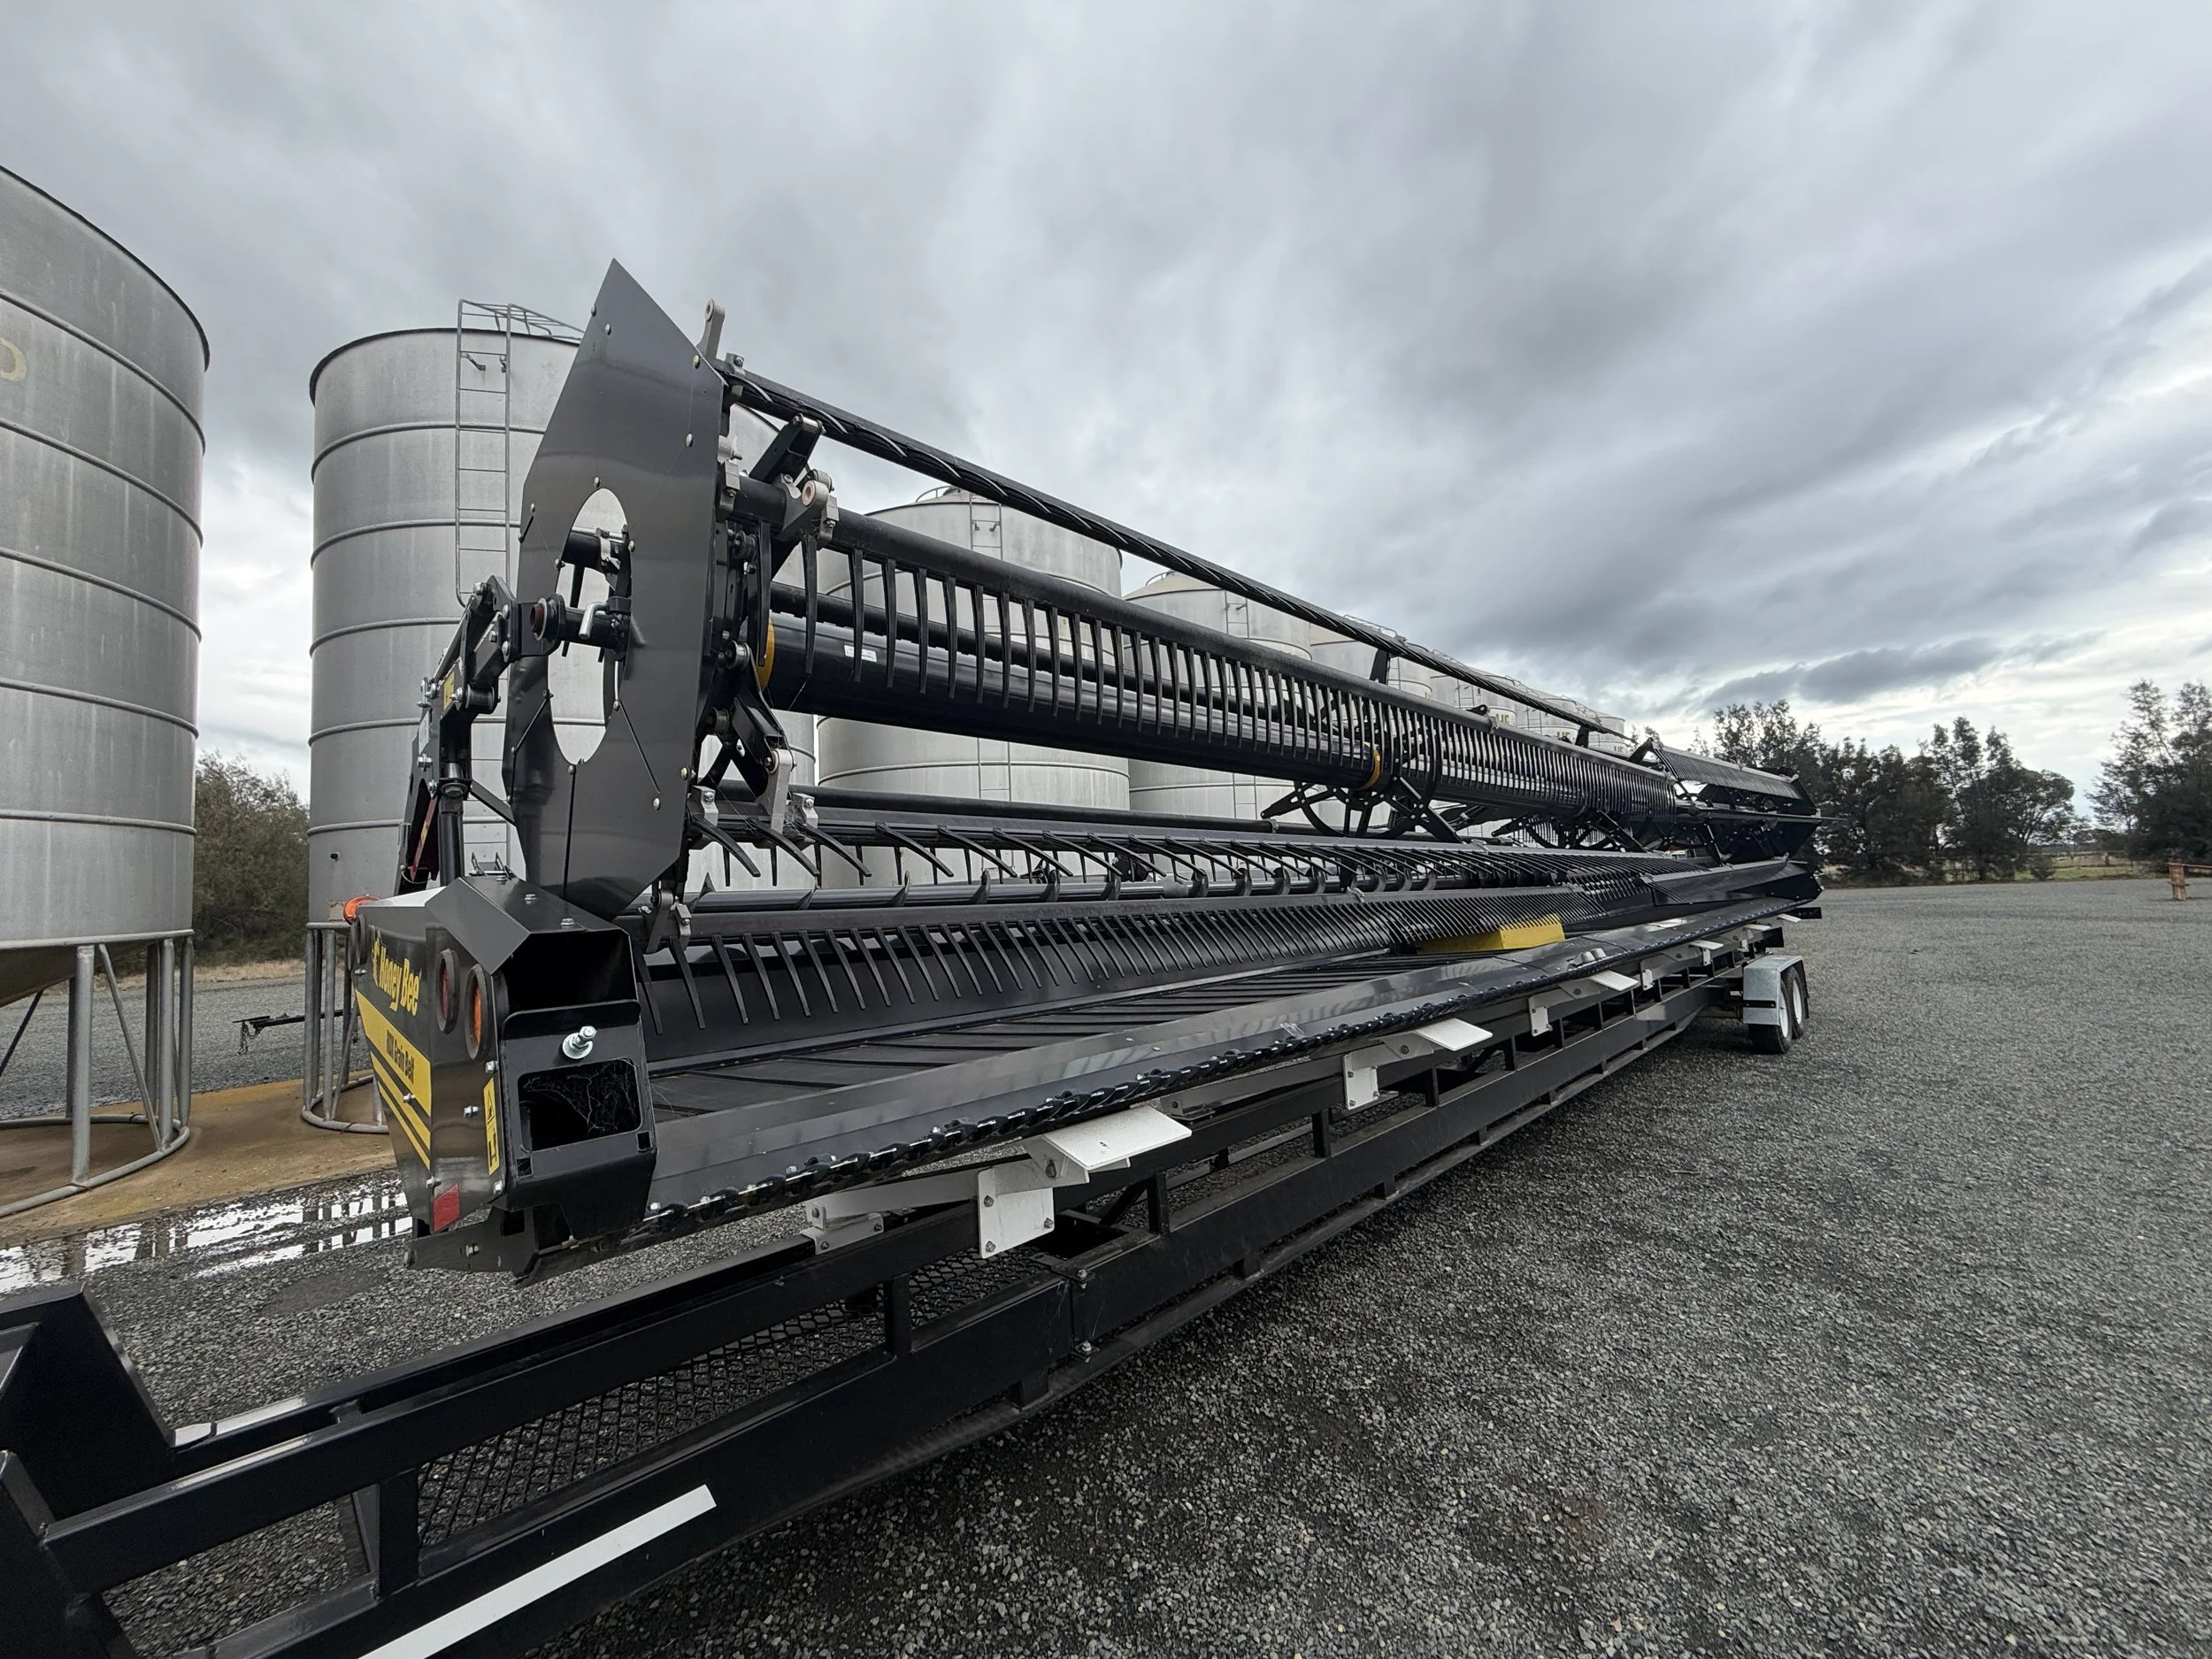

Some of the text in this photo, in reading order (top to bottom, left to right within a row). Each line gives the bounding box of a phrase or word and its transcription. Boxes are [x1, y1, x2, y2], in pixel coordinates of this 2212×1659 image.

[379, 946, 419, 1017] Honey Bee
[395, 1038, 405, 1073] Grain
[404, 1050, 415, 1086] Belt
